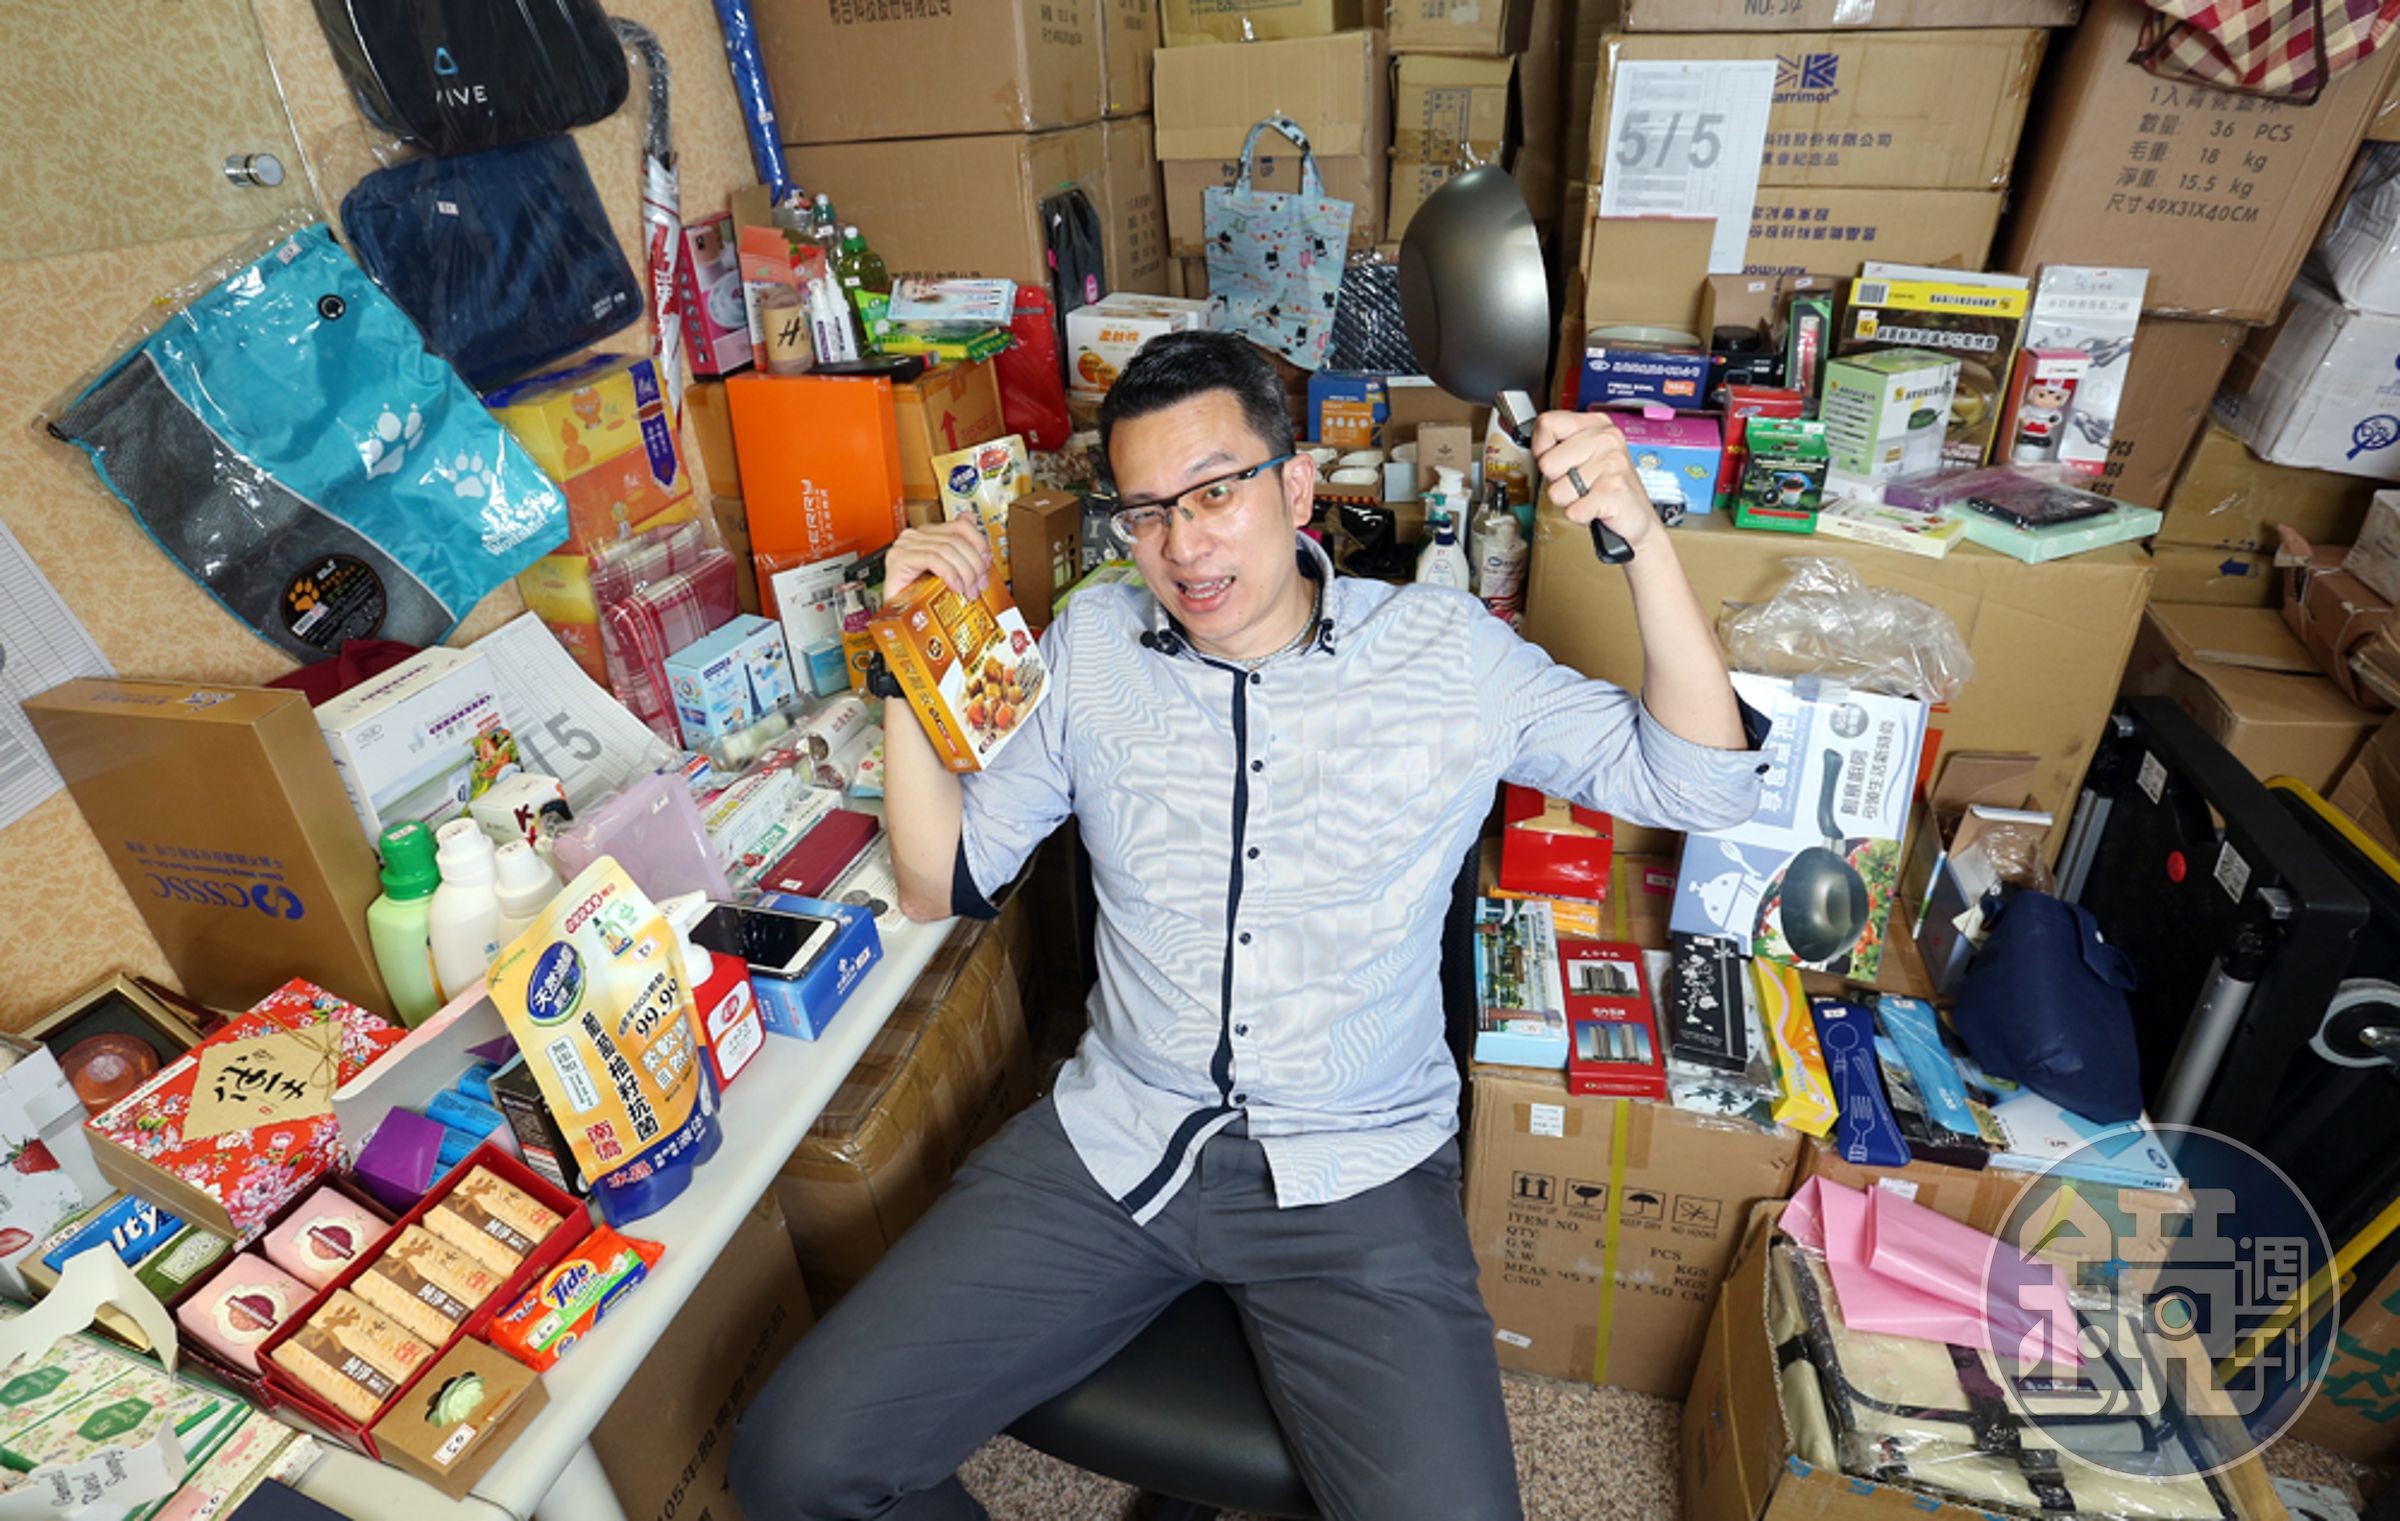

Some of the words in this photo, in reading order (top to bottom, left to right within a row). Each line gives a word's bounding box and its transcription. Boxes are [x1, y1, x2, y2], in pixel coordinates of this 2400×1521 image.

[1614, 111, 1724, 169] 5/5
[2209, 119, 2235, 138] 36
[2255, 123, 2294, 143] PCS
[2200, 147, 2219, 165] 18
[2243, 151, 2268, 173] kg
[2179, 174, 2215, 194] 15.5
[2230, 176, 2255, 199] kg
[1508, 1211, 1549, 1228] ITEM
[1651, 1247, 1682, 1261] PCS
[1676, 1264, 1710, 1278] KGS
[547, 1263, 589, 1308] Tide
[1674, 1277, 1709, 1291] KGS
